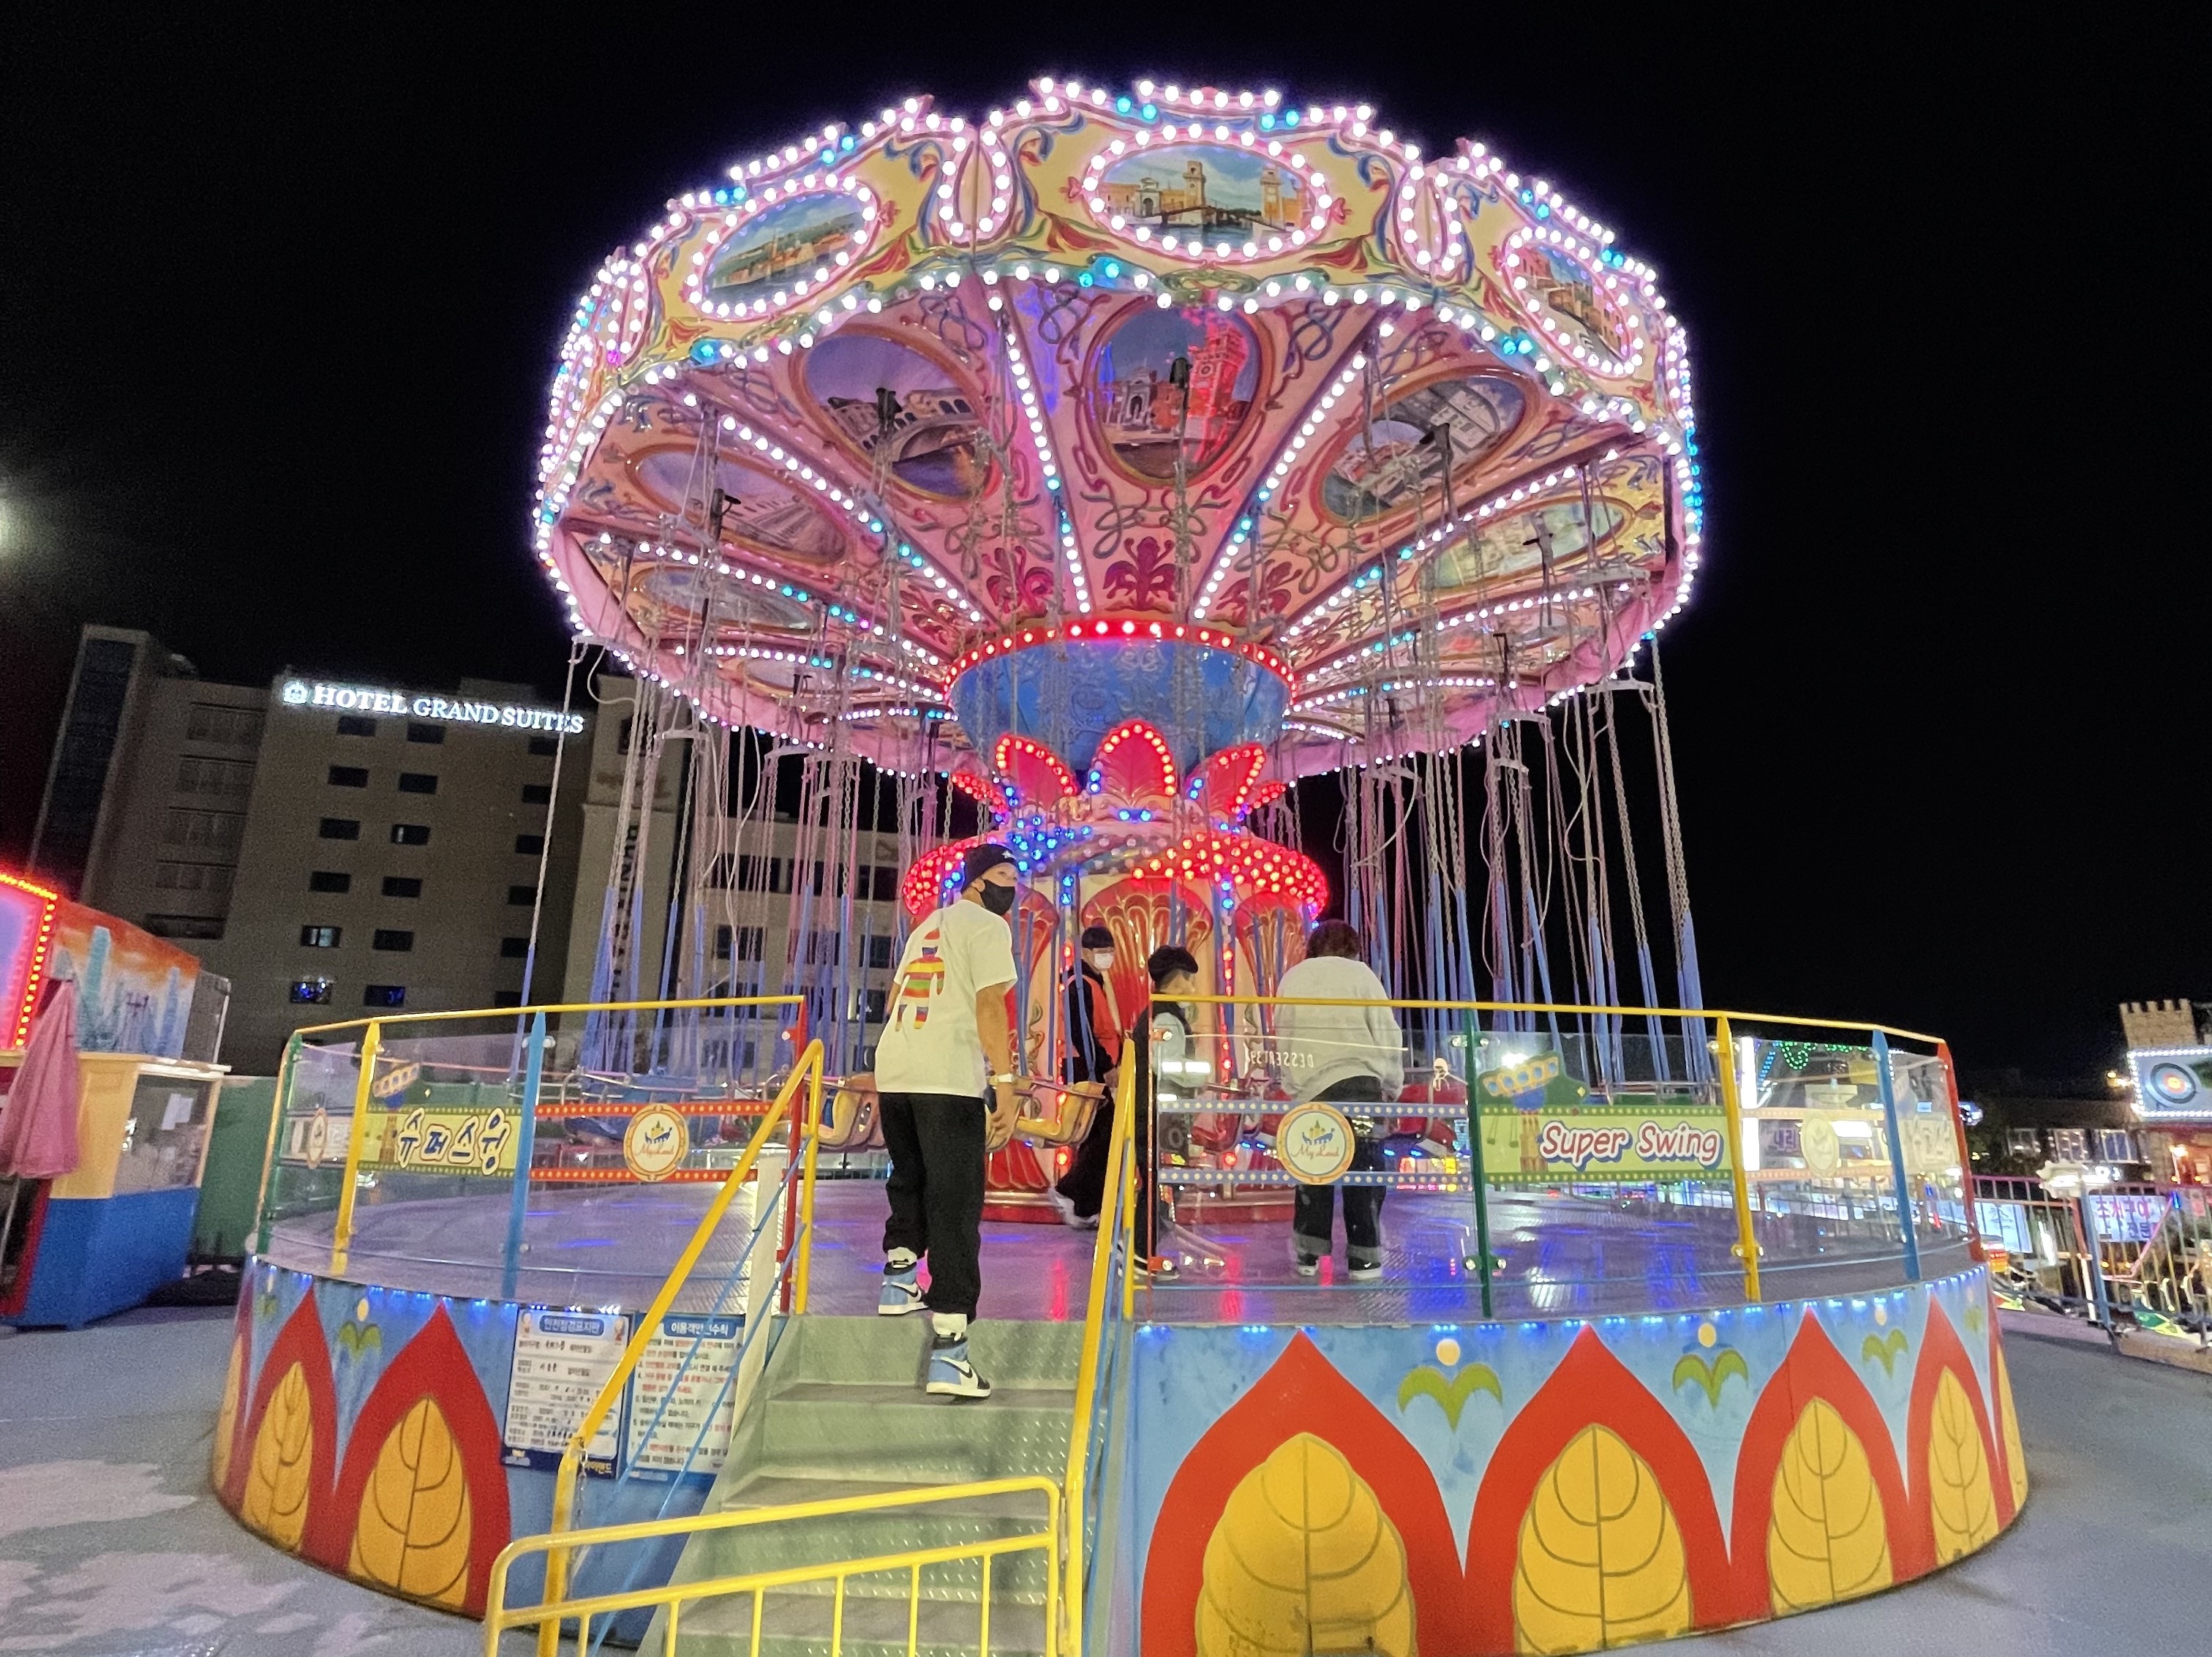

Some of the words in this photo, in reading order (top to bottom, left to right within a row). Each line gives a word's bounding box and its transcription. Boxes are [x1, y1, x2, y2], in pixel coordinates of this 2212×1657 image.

[312, 685, 408, 715] HOTEL
[413, 697, 499, 724] GRAND
[500, 707, 584, 734] SUITES
[399, 1110, 509, 1172] 슈퍼스윙
[1541, 1123, 1628, 1165] Super
[1637, 1123, 1719, 1163] Swing
